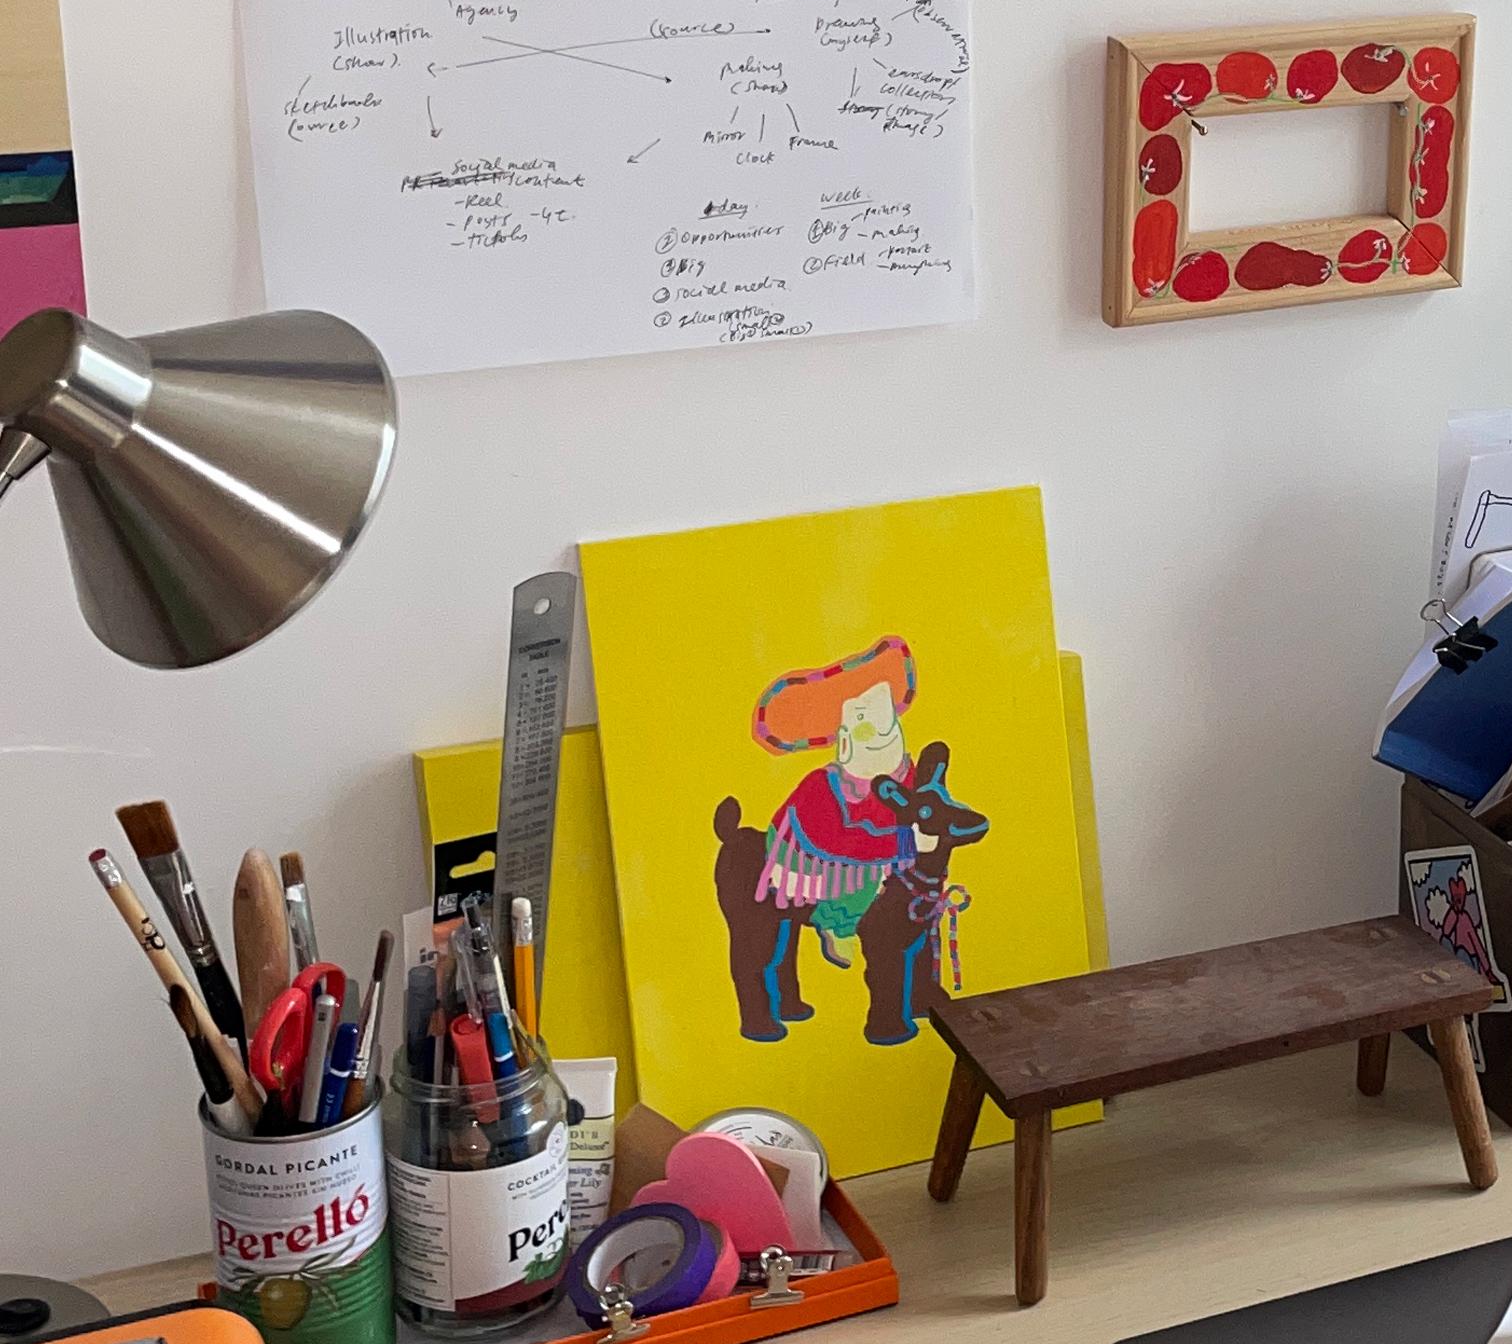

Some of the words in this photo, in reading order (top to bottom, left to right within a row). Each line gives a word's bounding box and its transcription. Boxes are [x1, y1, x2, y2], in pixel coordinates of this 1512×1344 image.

[215, 1154, 278, 1175] GORDAL
[285, 1144, 358, 1175] PICANTE
[216, 1182, 370, 1261] Perelló
